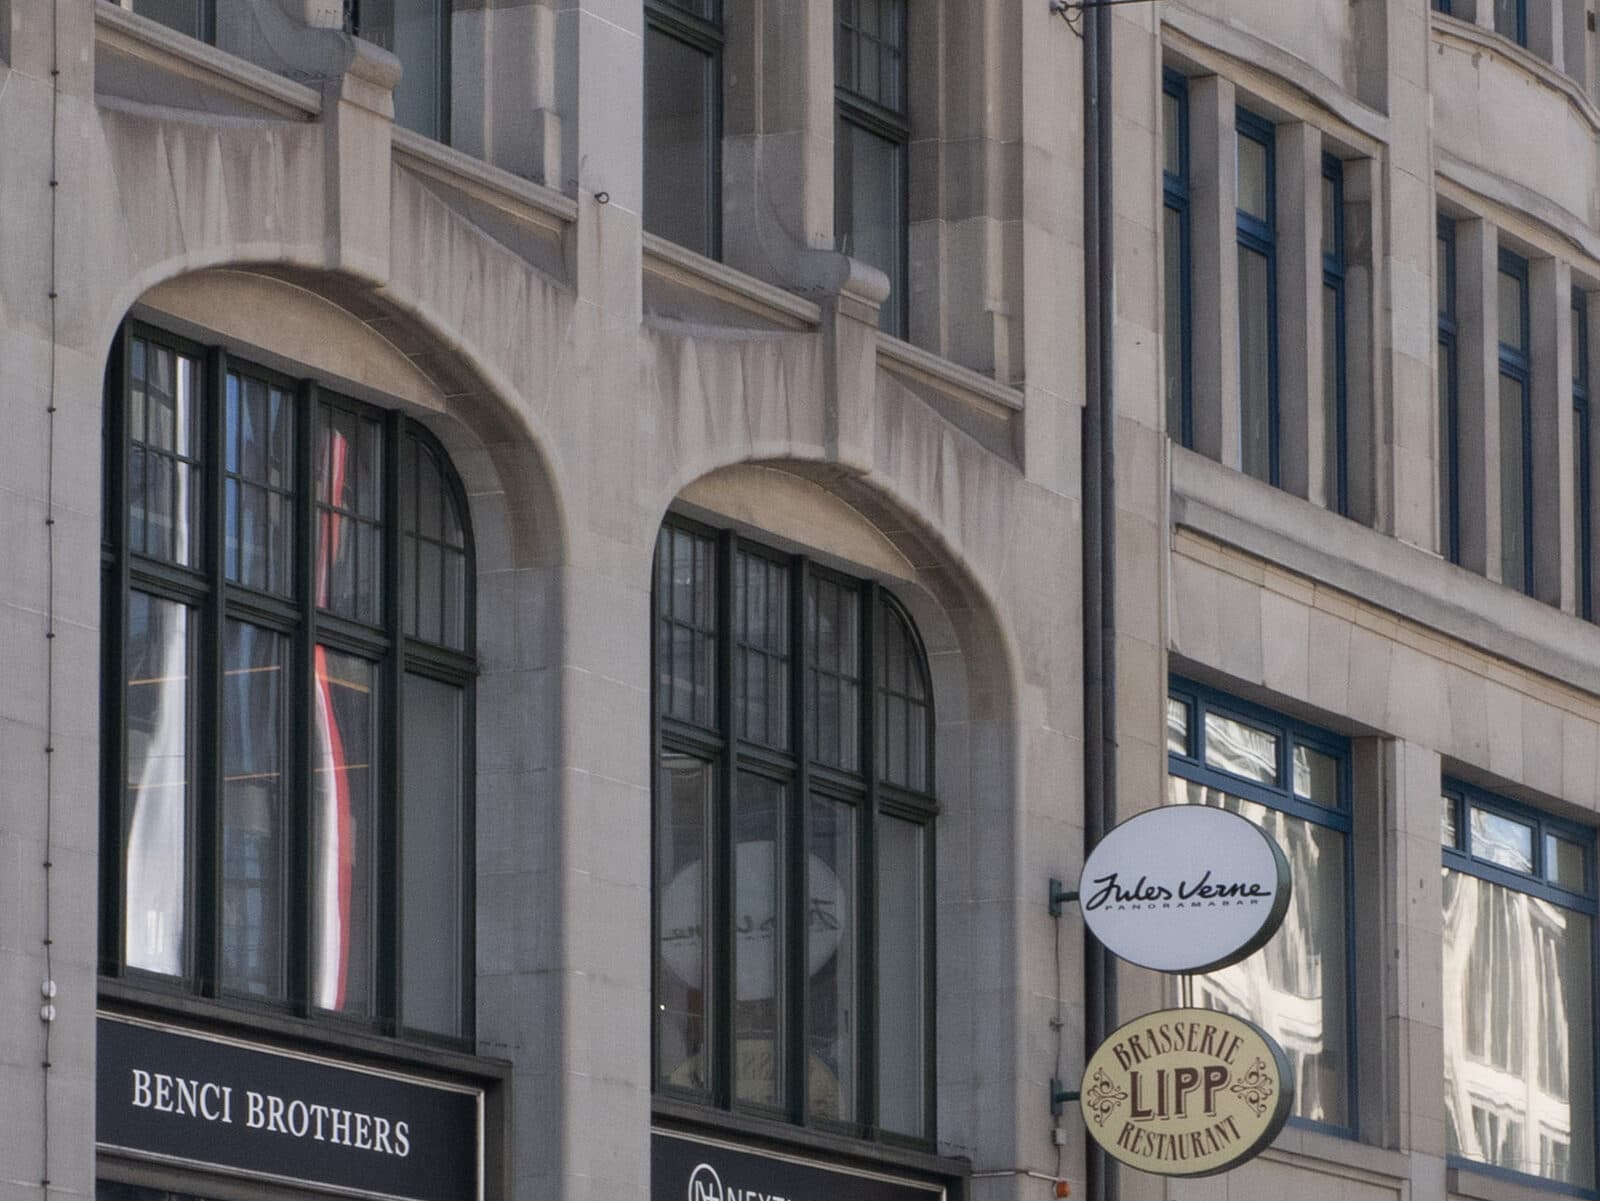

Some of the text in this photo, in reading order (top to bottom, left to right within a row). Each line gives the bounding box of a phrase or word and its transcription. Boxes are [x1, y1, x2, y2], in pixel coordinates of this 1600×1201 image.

[1086, 870, 1272, 911] Jules Verne
[1112, 1022, 1245, 1072] BRASSERIE
[131, 1068, 410, 1158] BENCI BROTHERS
[1129, 1065, 1232, 1122] LIPP
[1116, 1115, 1242, 1162] RESTAURANT
